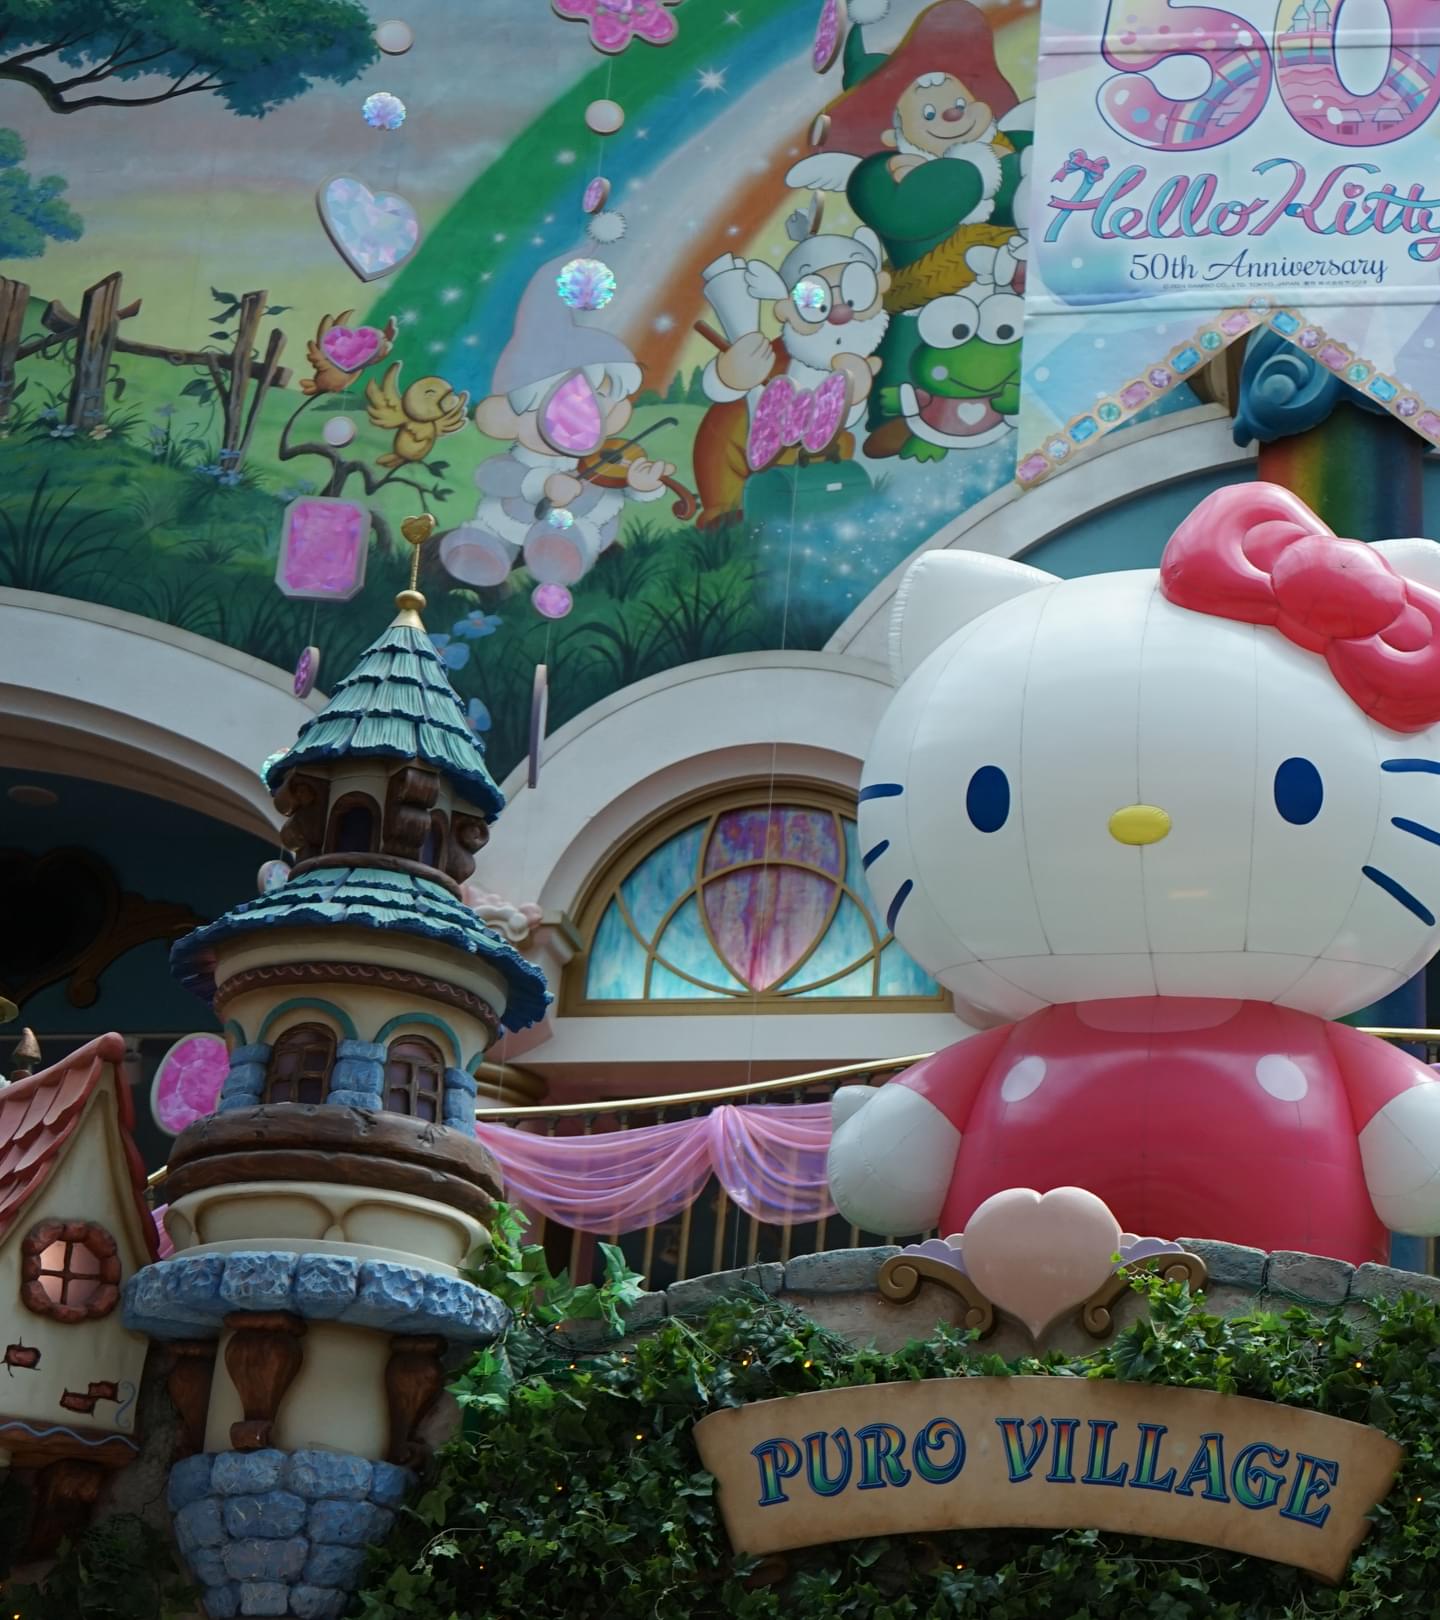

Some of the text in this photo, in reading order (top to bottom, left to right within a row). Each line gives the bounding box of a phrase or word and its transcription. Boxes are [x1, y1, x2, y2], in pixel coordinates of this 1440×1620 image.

[1043, 148, 1265, 243] Hello
[1129, 247, 1388, 283] 50th Anniversary
[750, 1415, 1340, 1529] PURO VILLAGE
